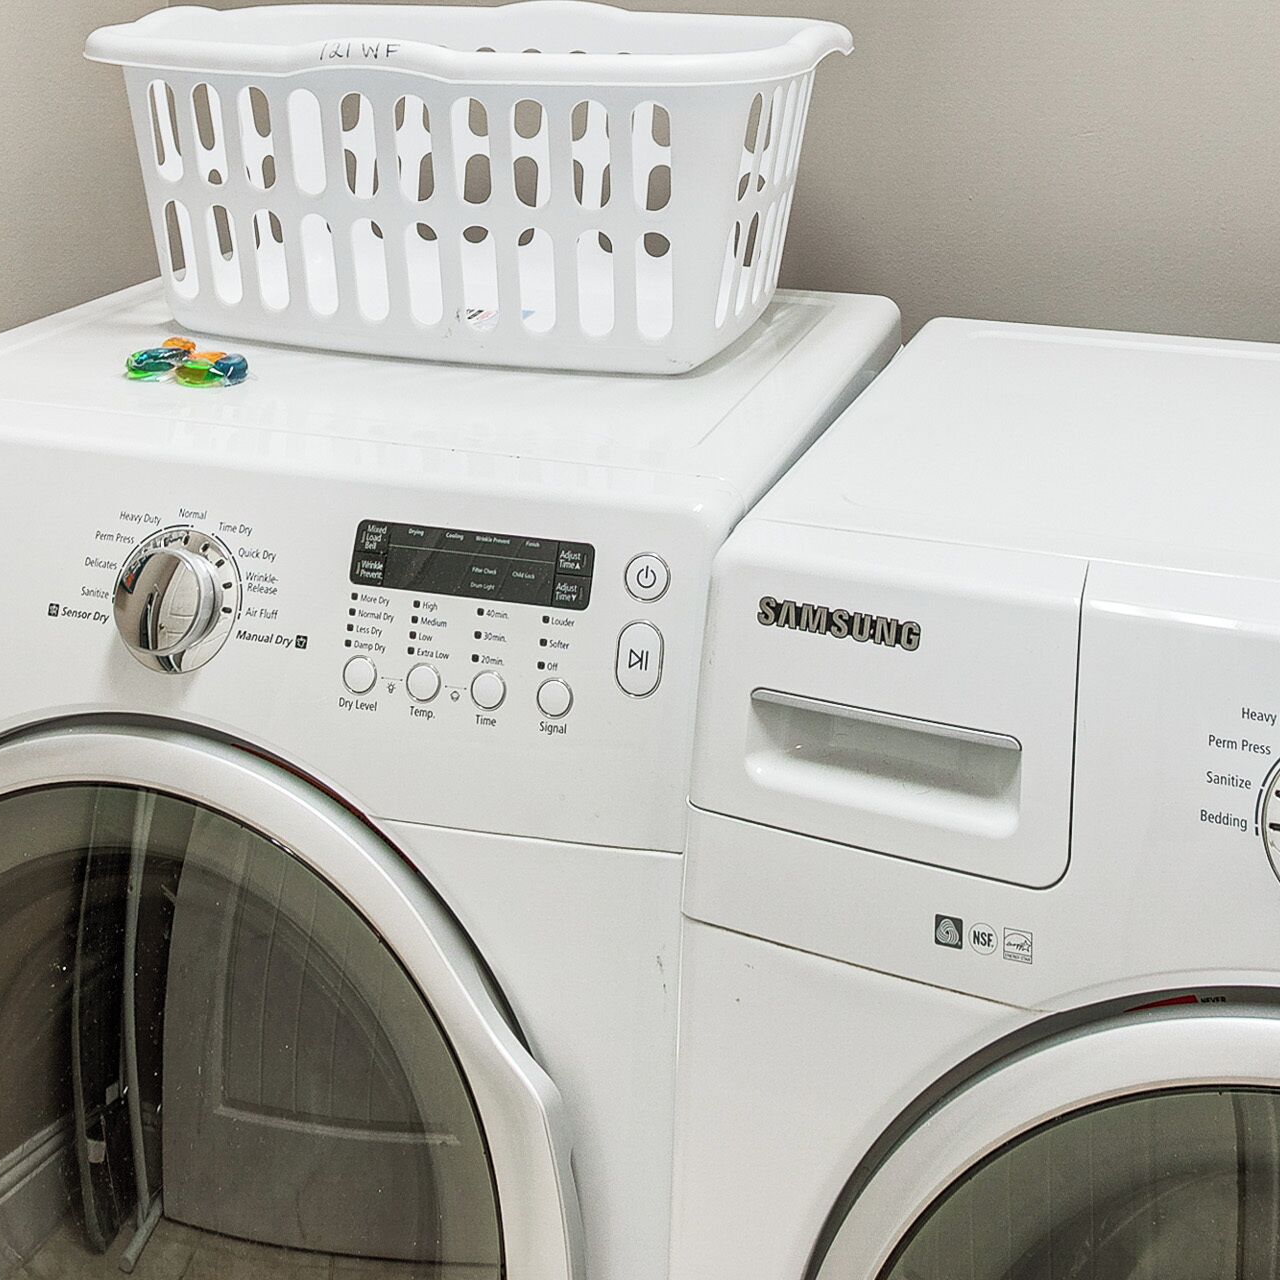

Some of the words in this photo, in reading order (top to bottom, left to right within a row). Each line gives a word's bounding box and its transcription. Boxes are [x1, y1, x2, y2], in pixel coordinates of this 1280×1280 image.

[120, 511, 142, 523] Heavy
[144, 513, 162, 526] Duty
[178, 508, 208, 520] Normal
[219, 522, 237, 533] Time
[239, 523, 253, 537] Dry
[367, 524, 388, 535] Mixed
[445, 531, 465, 541] Cooling
[95, 530, 114, 542] Perm
[115, 532, 135, 544] Press
[365, 533, 382, 541] Load
[364, 541, 377, 550] Bell
[238, 547, 261, 559] Quick
[262, 549, 277, 563] Dry
[559, 550, 582, 561] Adjust
[84, 556, 118, 570] Delicates
[361, 560, 384, 570] Wrinkle
[559, 560, 575, 569] Time
[81, 586, 110, 599] Sanitize
[247, 583, 278, 595] Release
[555, 582, 578, 594] Adjust
[360, 594, 378, 604] More
[379, 596, 390, 607] Dry
[555, 592, 571, 602] Time
[245, 607, 257, 618] Air
[260, 608, 279, 620] Fluff
[422, 602, 438, 613] High
[61, 606, 92, 620] Sensor
[93, 611, 110, 625] Dry
[358, 609, 382, 620] Normal
[383, 612, 395, 624] Dry
[420, 616, 448, 628] Medium
[551, 617, 575, 627] Louder
[757, 596, 922, 652] SAMSUNG
[356, 625, 370, 634] Less
[371, 627, 383, 638] Dry
[418, 633, 433, 642] Low
[236, 629, 274, 643] Manual
[274, 634, 295, 649] Dry
[549, 639, 570, 650] Softer
[354, 640, 373, 652] Damp
[374, 642, 386, 654] Dry
[416, 648, 434, 658] Extra
[435, 650, 450, 660] Low
[546, 662, 558, 671] Off
[338, 696, 354, 711] Dry
[355, 699, 378, 712] Level
[409, 705, 436, 720] Temp.
[1241, 707, 1277, 727] Heavy
[475, 714, 497, 727] Time
[539, 721, 568, 736] Signal
[1208, 734, 1238, 751] Perm
[1241, 739, 1272, 756] Press
[1206, 770, 1252, 789] Sanitize
[1200, 809, 1248, 832] Bedding
[973, 930, 994, 948] NSF
